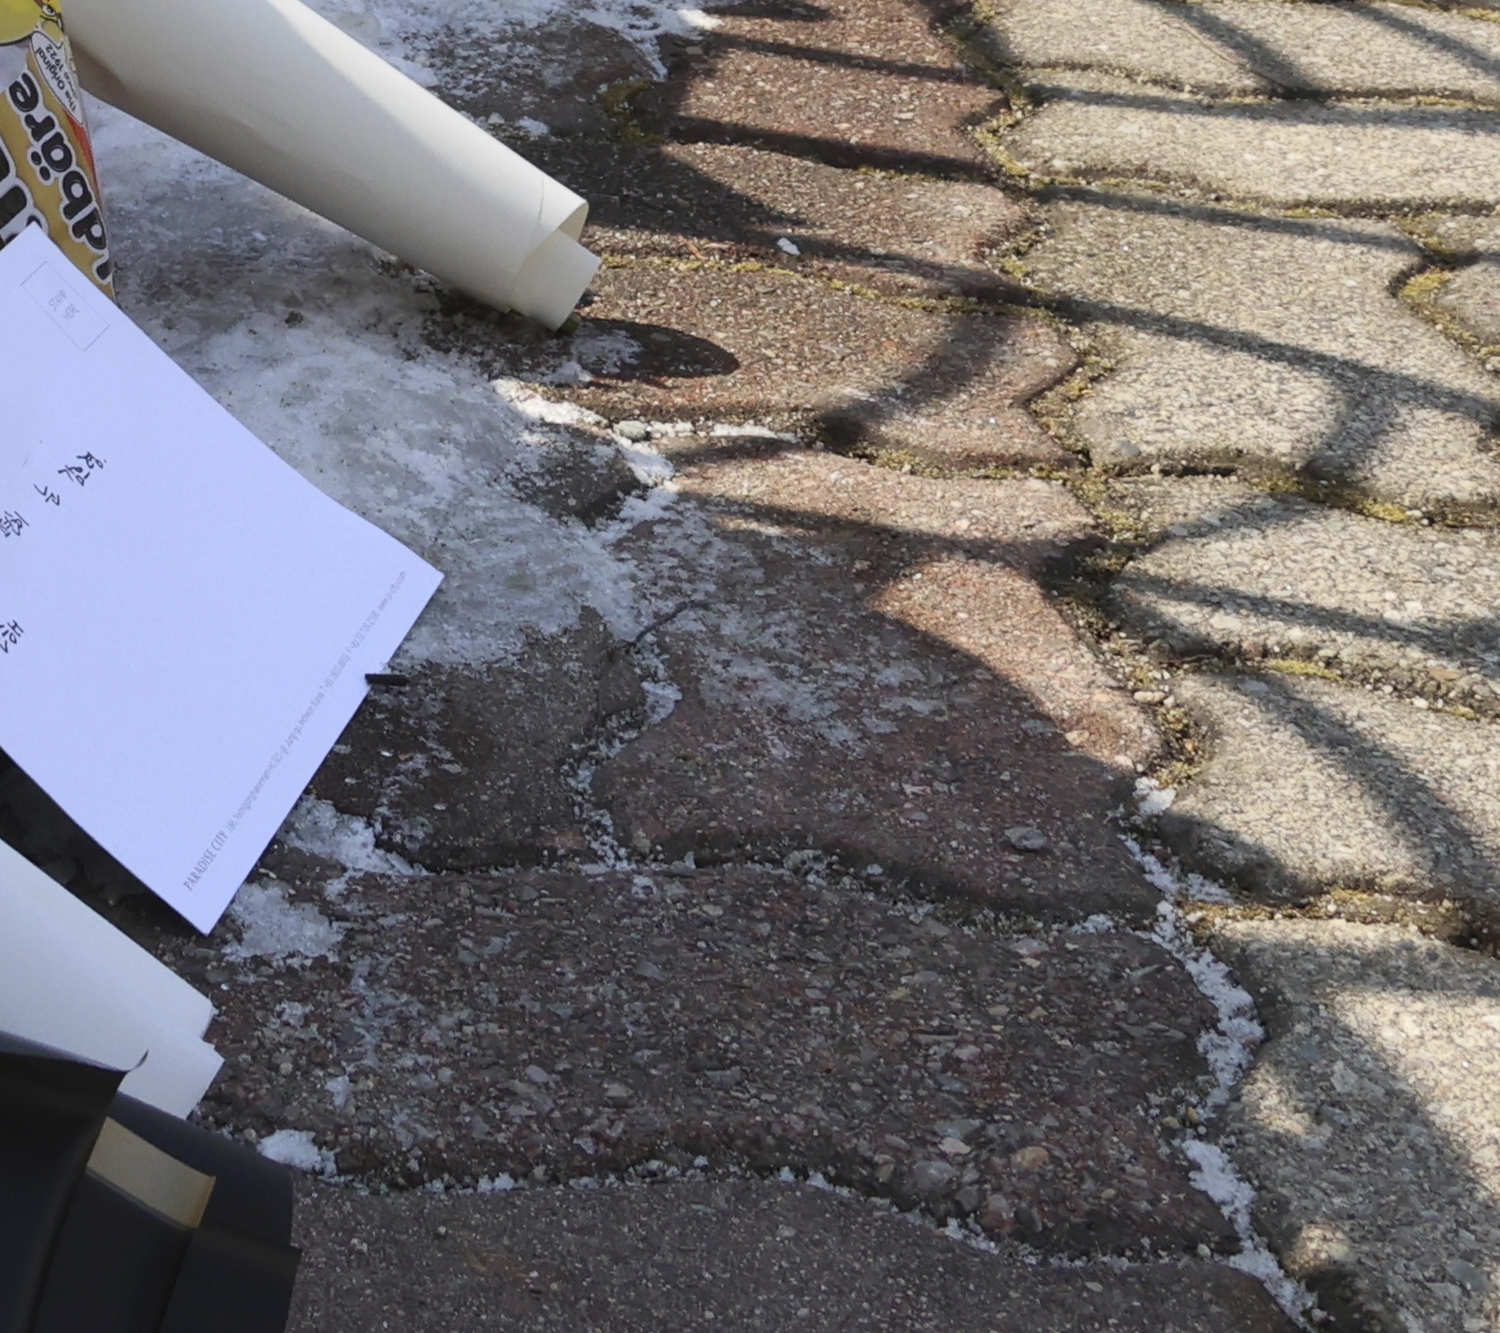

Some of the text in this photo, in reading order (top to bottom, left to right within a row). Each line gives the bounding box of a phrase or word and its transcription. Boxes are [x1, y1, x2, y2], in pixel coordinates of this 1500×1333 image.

[36, 46, 65, 90] Original
[48, 43, 64, 70] 1922
[181, 829, 230, 891] PARADISE CITY
